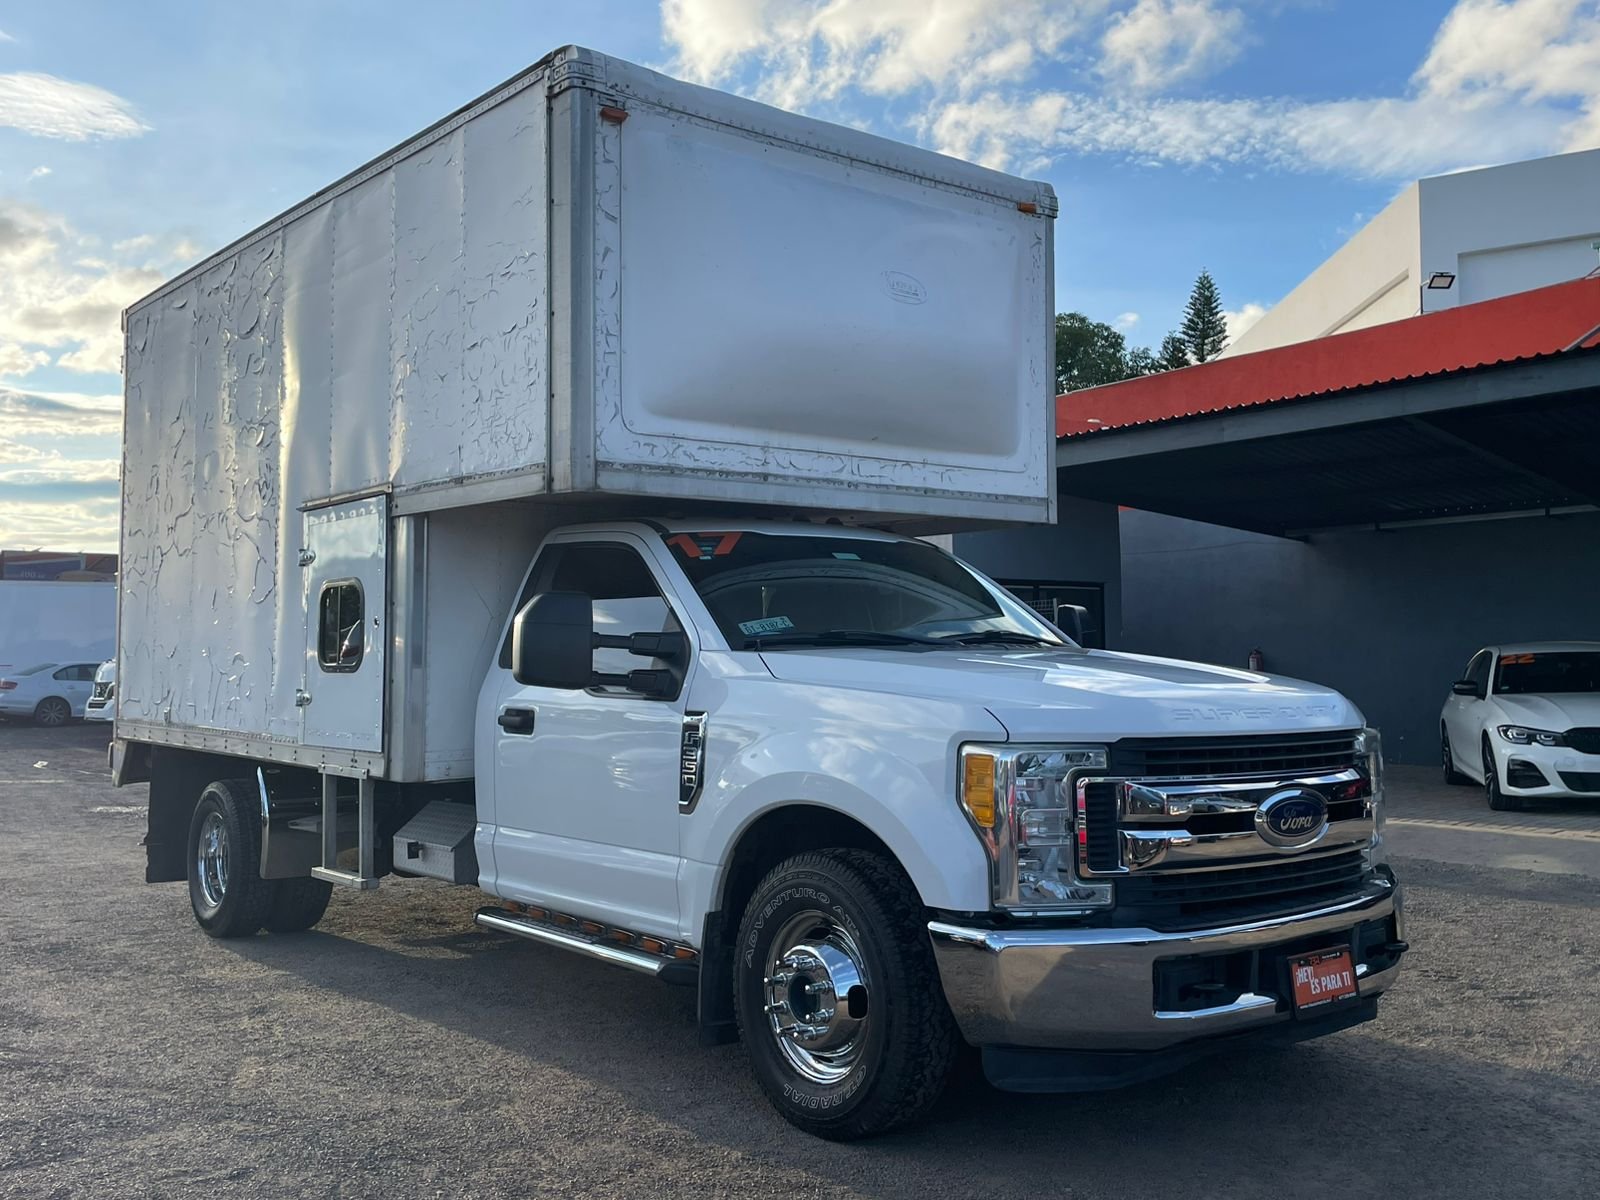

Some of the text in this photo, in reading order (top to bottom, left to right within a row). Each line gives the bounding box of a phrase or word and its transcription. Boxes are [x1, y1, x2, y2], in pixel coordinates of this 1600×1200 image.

[1500, 653, 1536, 665] 22
[1172, 707, 1274, 721] SUPER
[1281, 805, 1313, 830] Ford
[744, 887, 831, 969] ADVENTURO
[1310, 971, 1351, 995] ES PARA TI
[783, 1083, 843, 1109] RADIAL
